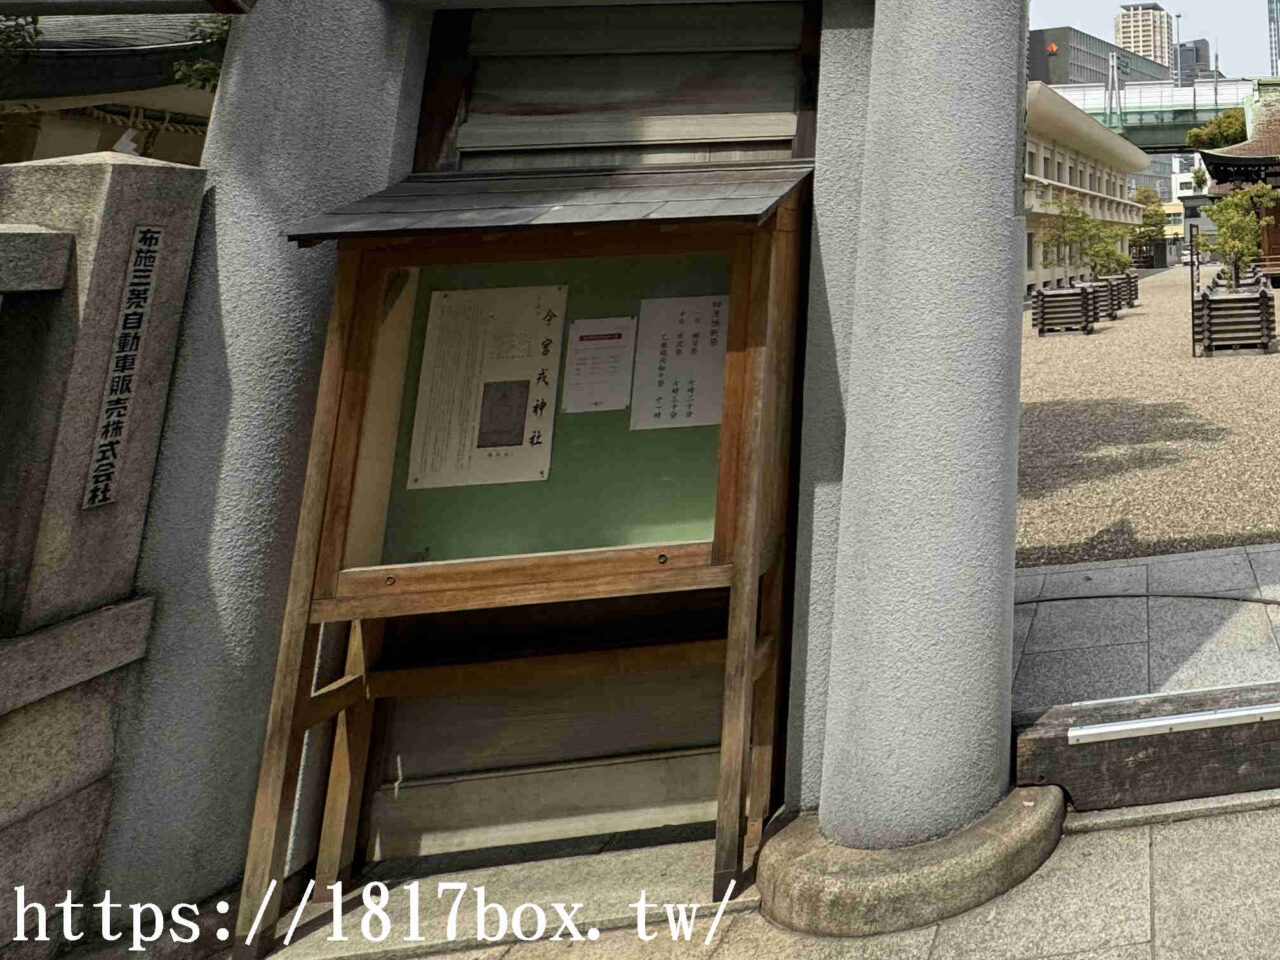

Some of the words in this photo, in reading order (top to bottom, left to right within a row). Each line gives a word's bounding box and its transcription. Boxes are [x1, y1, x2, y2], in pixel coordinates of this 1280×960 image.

[88, 227, 161, 506] 布施三菱自動車販売株式会社
[529, 307, 558, 448] 今宮戎神社
